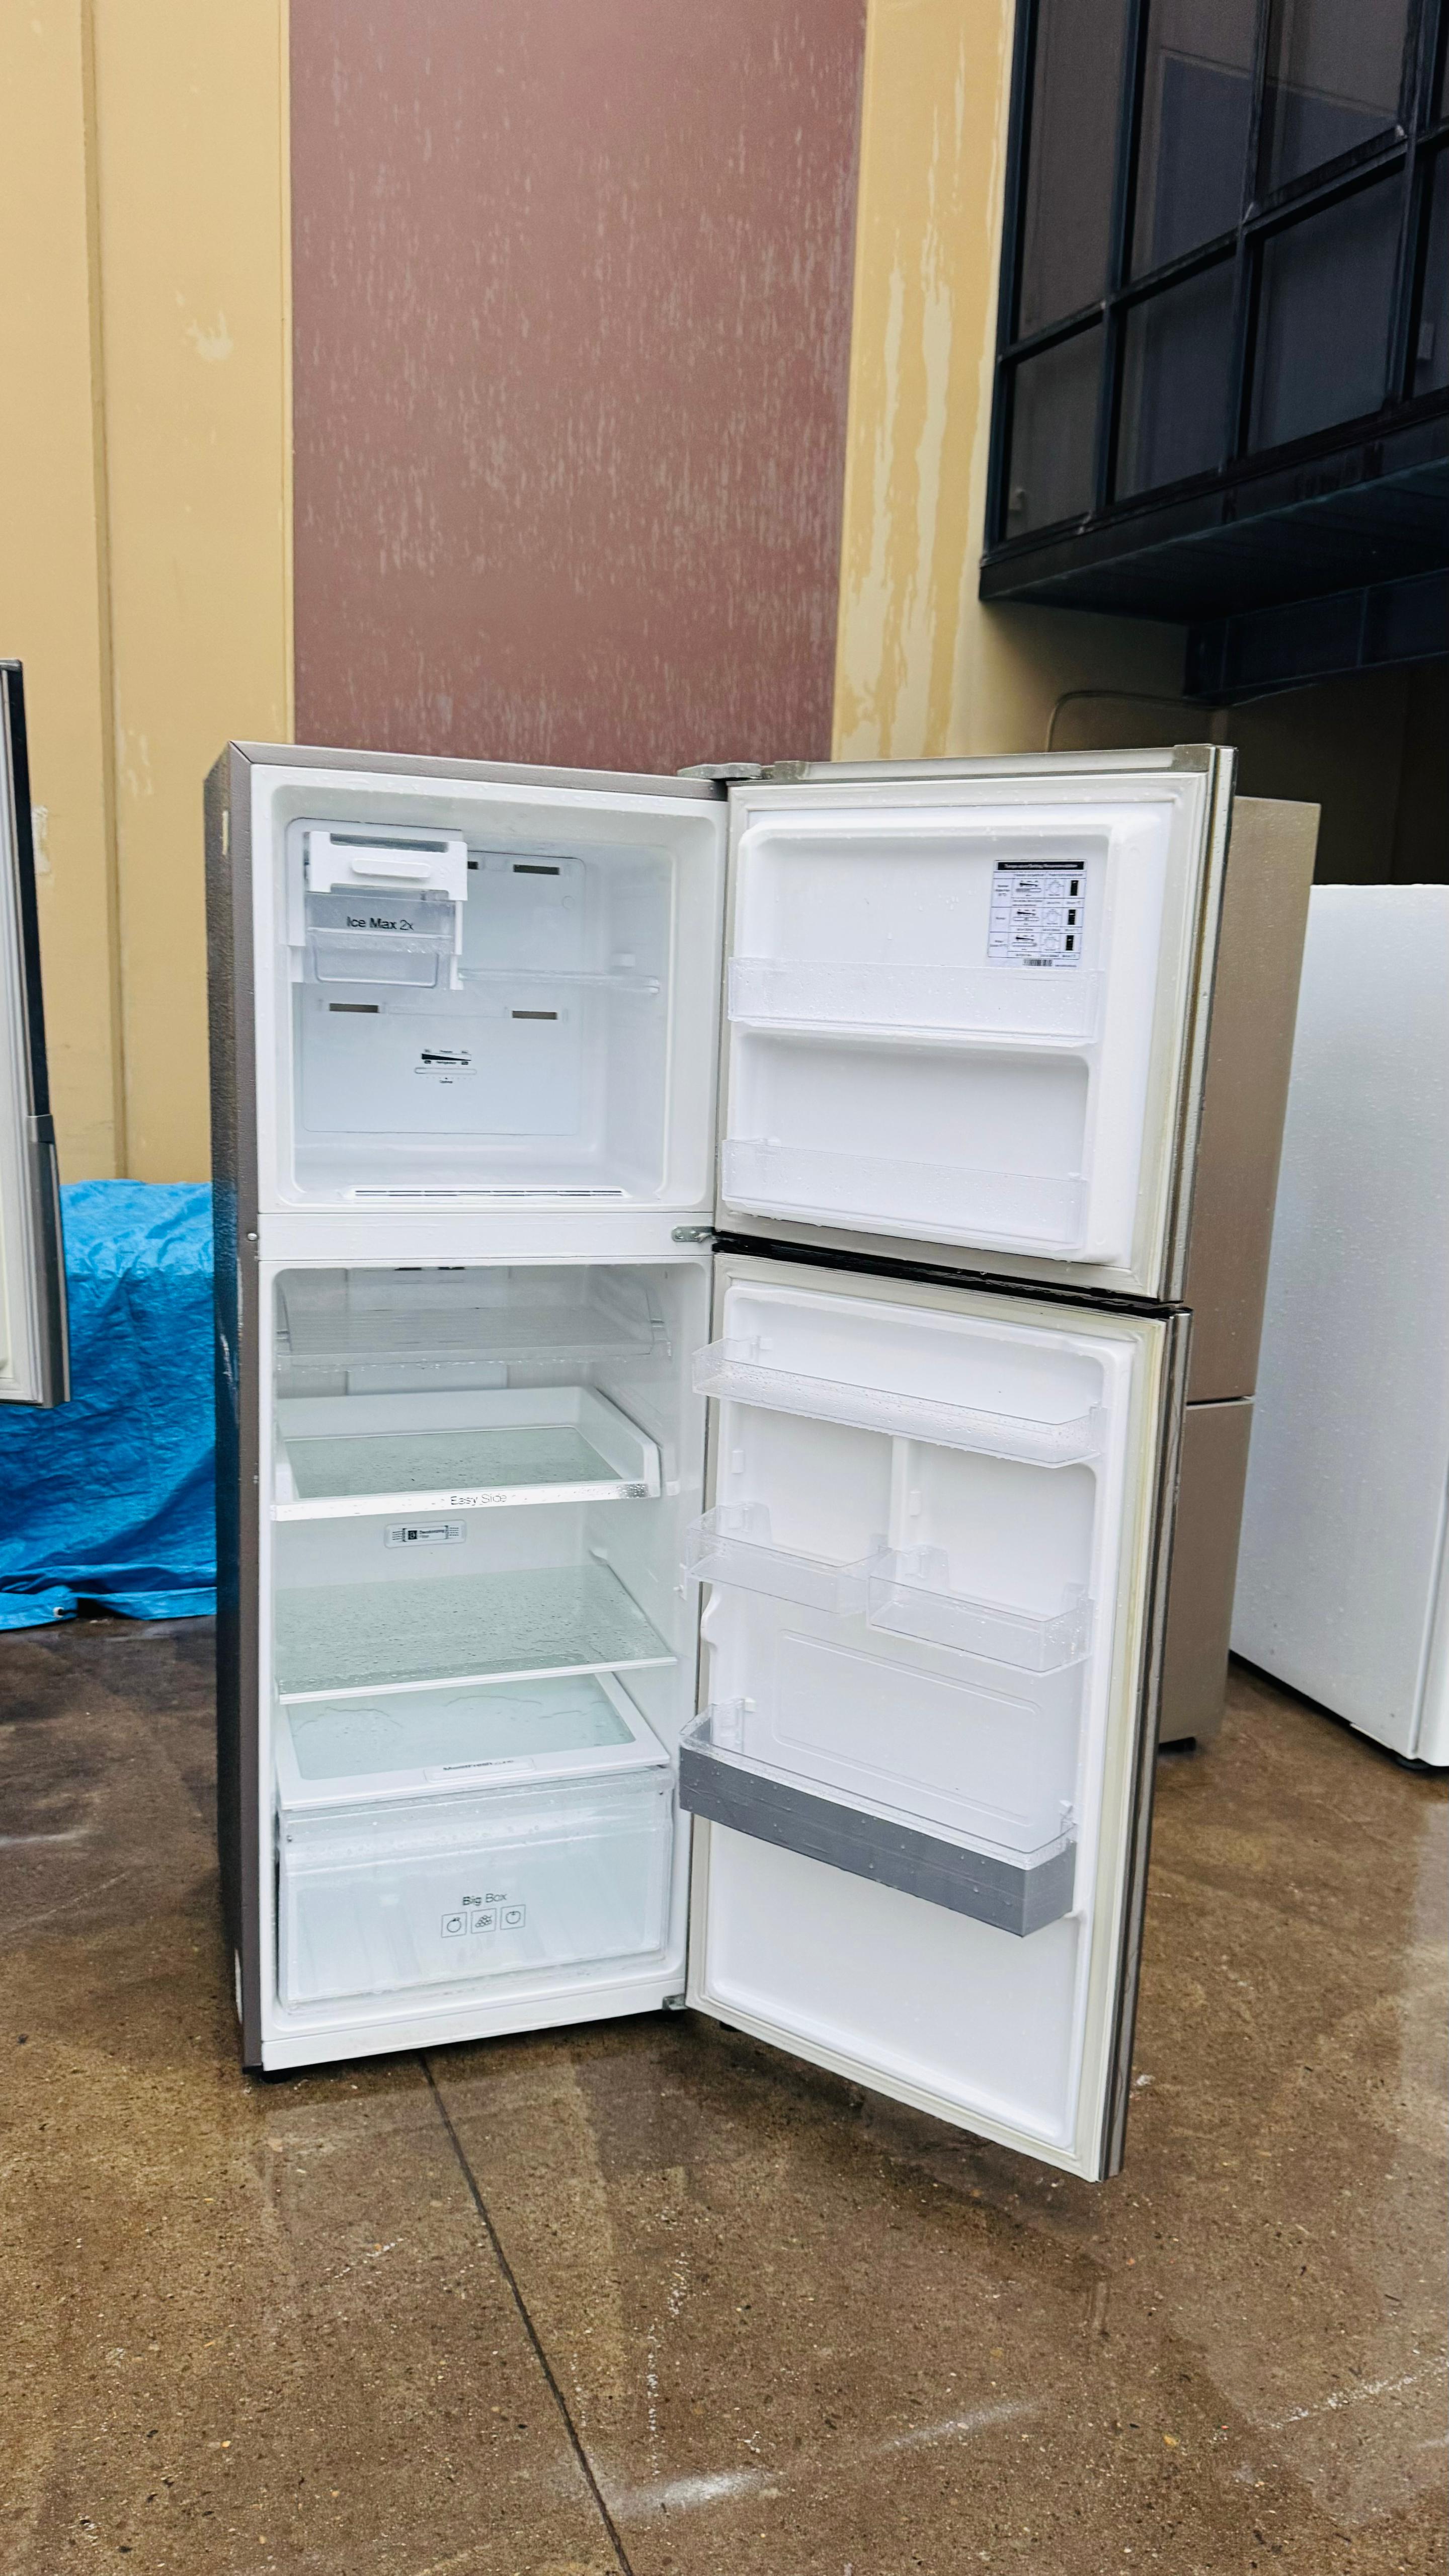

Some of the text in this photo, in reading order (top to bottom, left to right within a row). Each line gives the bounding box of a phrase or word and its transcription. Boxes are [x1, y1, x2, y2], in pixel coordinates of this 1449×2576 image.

[347, 917, 414, 930] Ice Max 2x
[451, 1496, 477, 1506] Easy
[462, 1893, 507, 1906] Big Box
